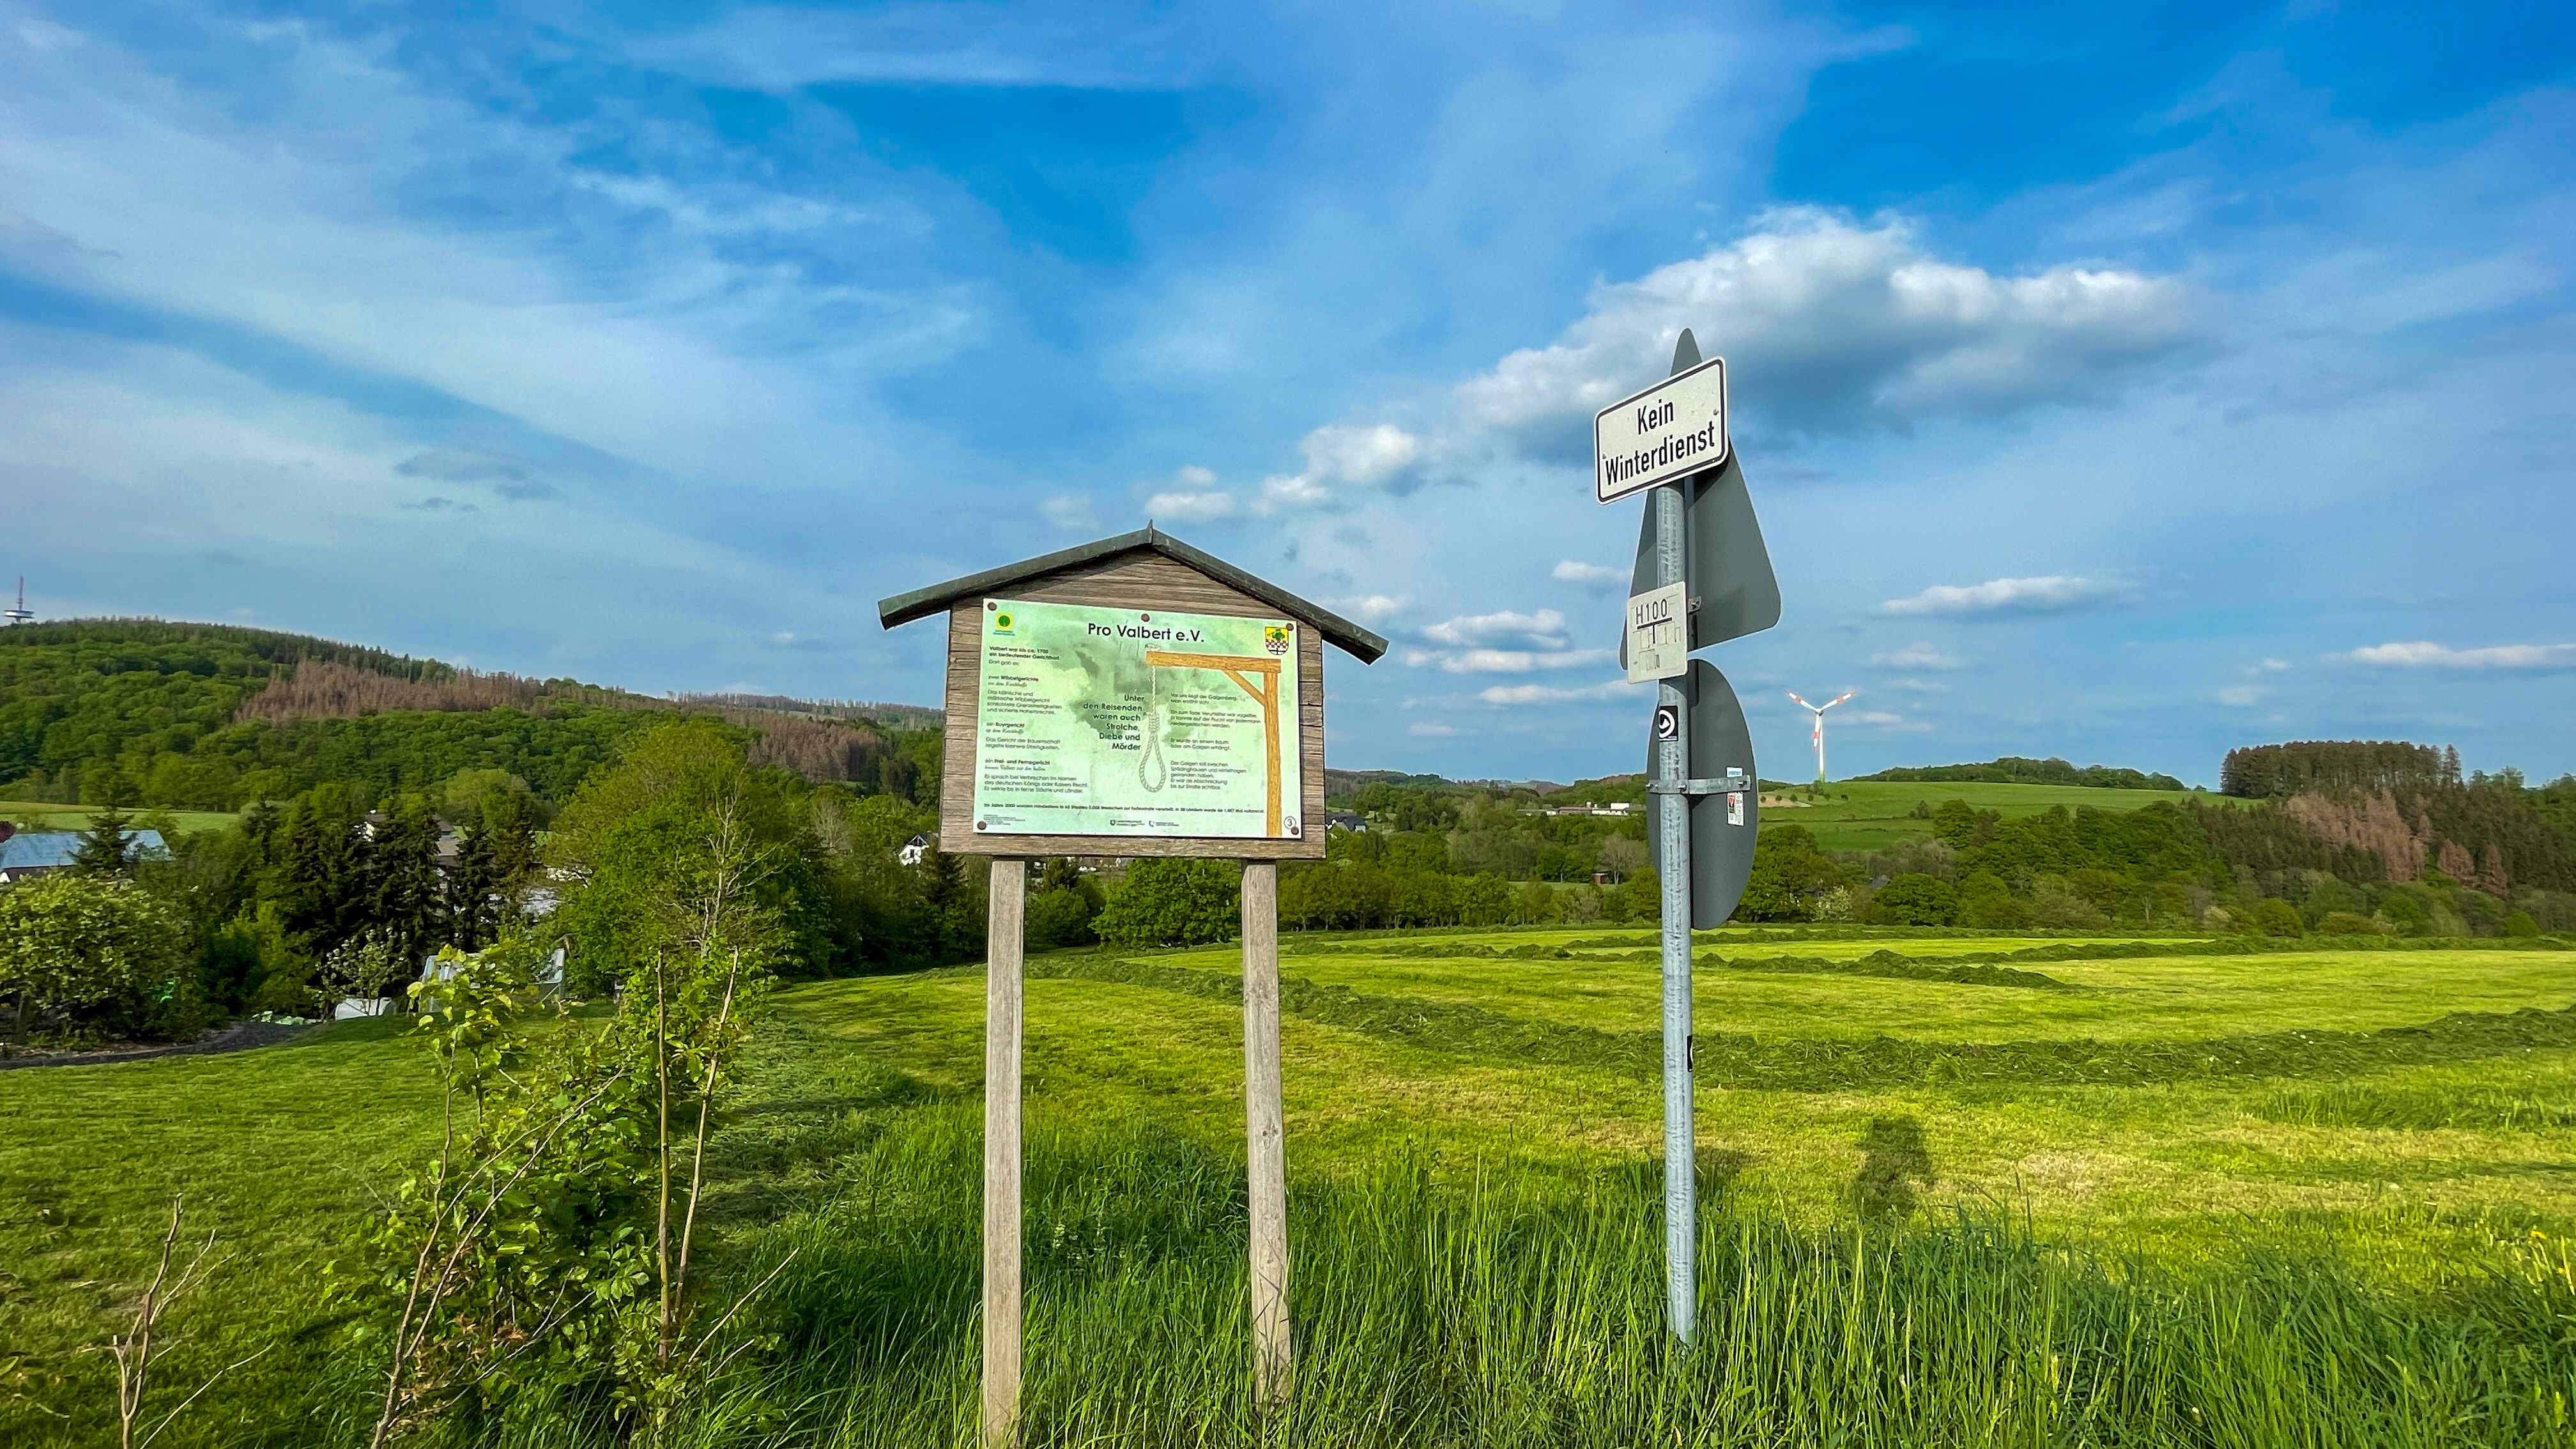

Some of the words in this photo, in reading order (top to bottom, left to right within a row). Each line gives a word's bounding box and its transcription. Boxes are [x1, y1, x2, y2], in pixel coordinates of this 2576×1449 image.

[1637, 399, 1674, 435] Kein
[1606, 421, 1715, 486] Winterdienst
[1636, 599, 1667, 625] H100
[1088, 623, 1111, 636] Pro
[1117, 625, 1171, 640] Valbert
[1176, 629, 1204, 643] e.V.
[1101, 703, 1142, 712] Reisenden
[1106, 723, 1140, 732] Strolche,
[1112, 742, 1141, 751] Mörder
[1287, 818, 1293, 827] 3
